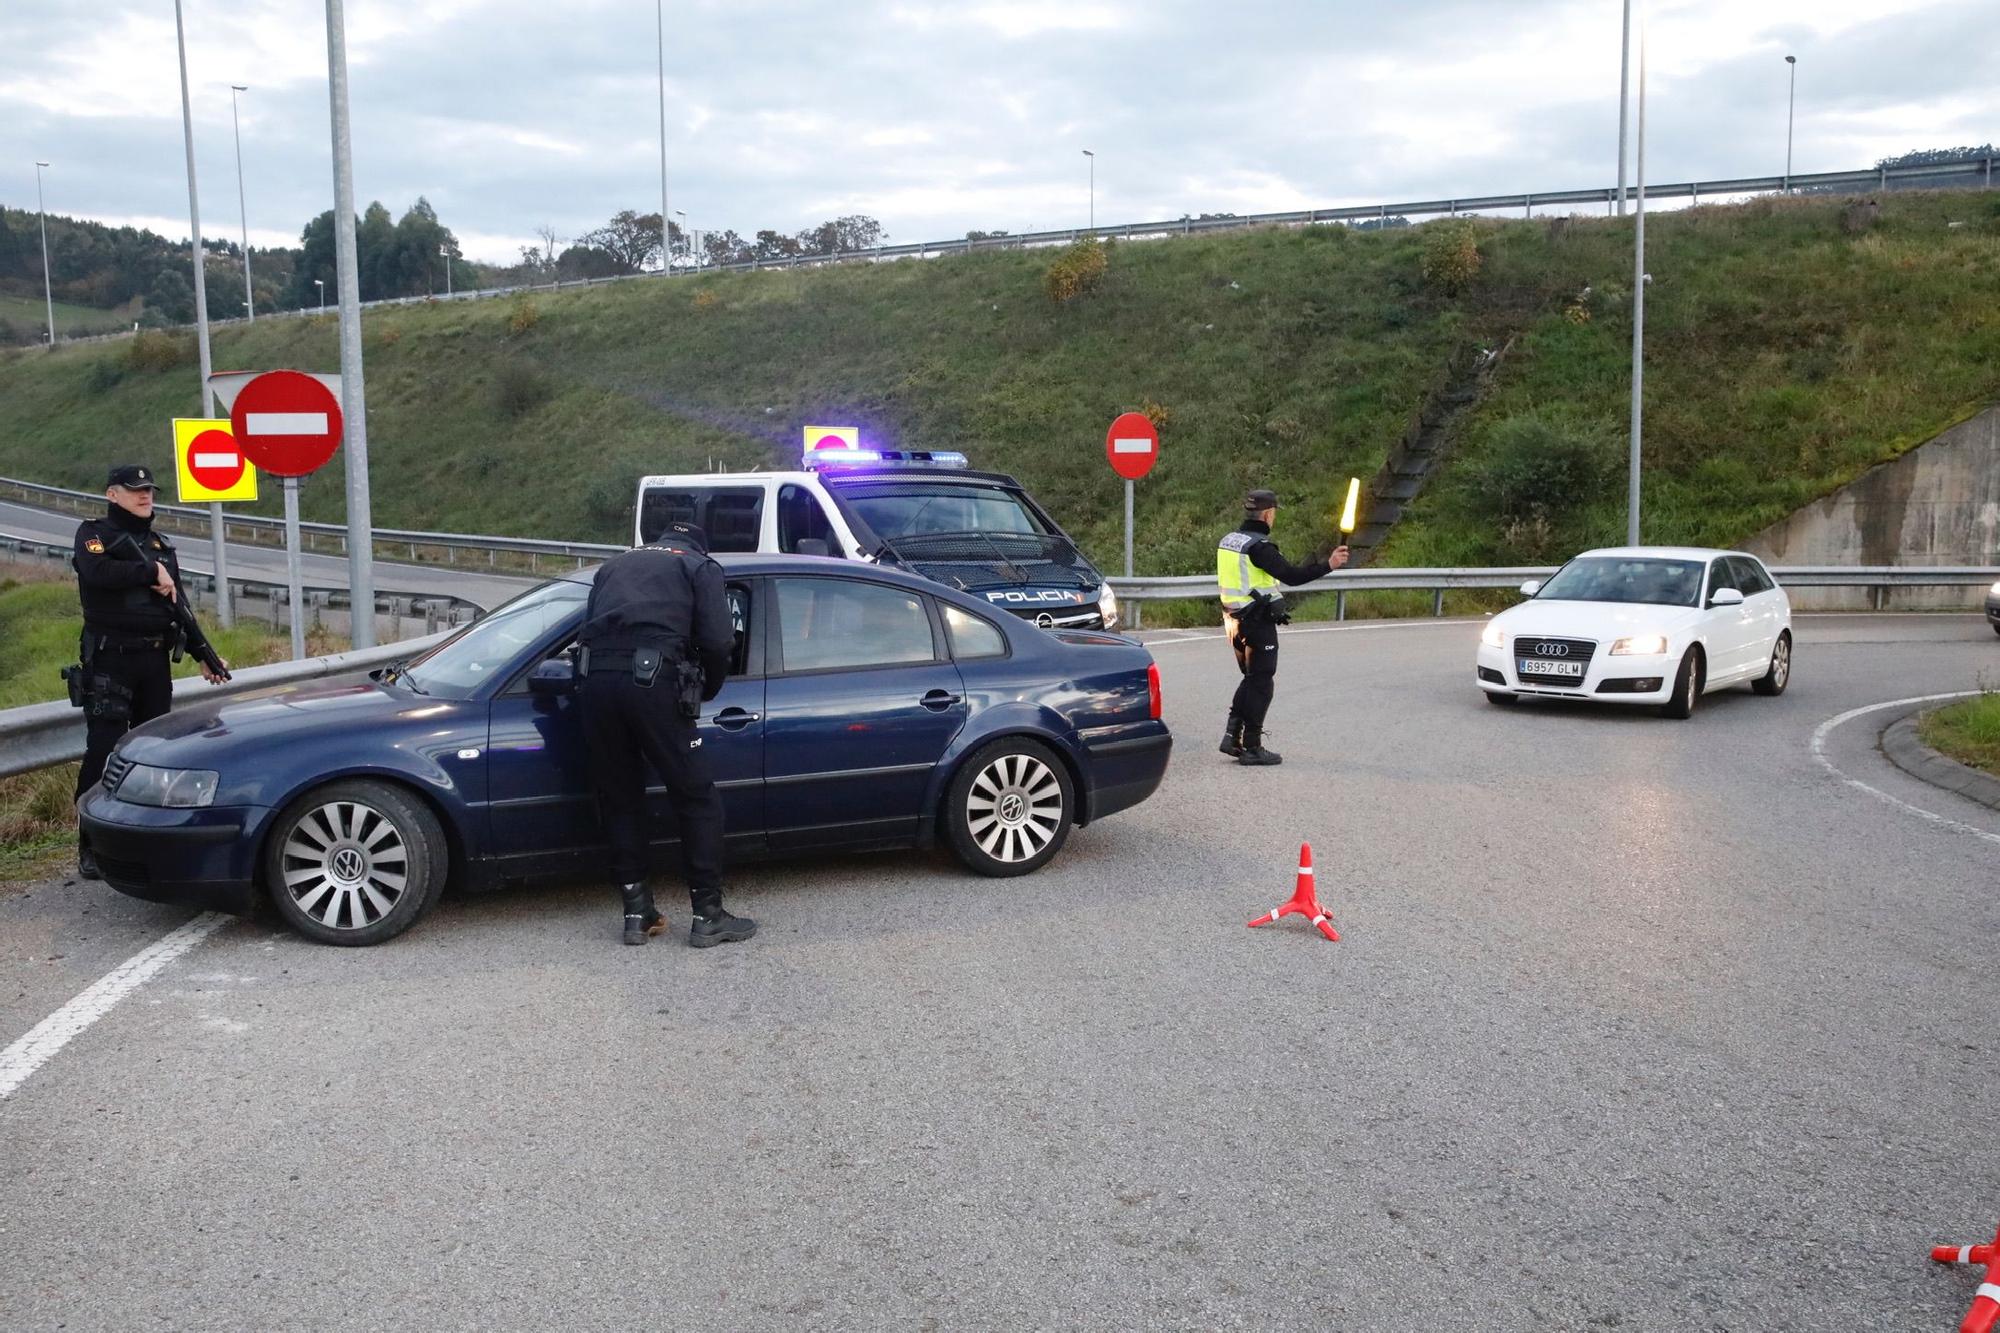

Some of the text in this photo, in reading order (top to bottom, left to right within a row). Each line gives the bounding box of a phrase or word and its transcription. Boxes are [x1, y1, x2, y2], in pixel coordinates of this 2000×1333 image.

[1527, 662, 1578, 674] 6957 GLM
[333, 849, 363, 880] VW
